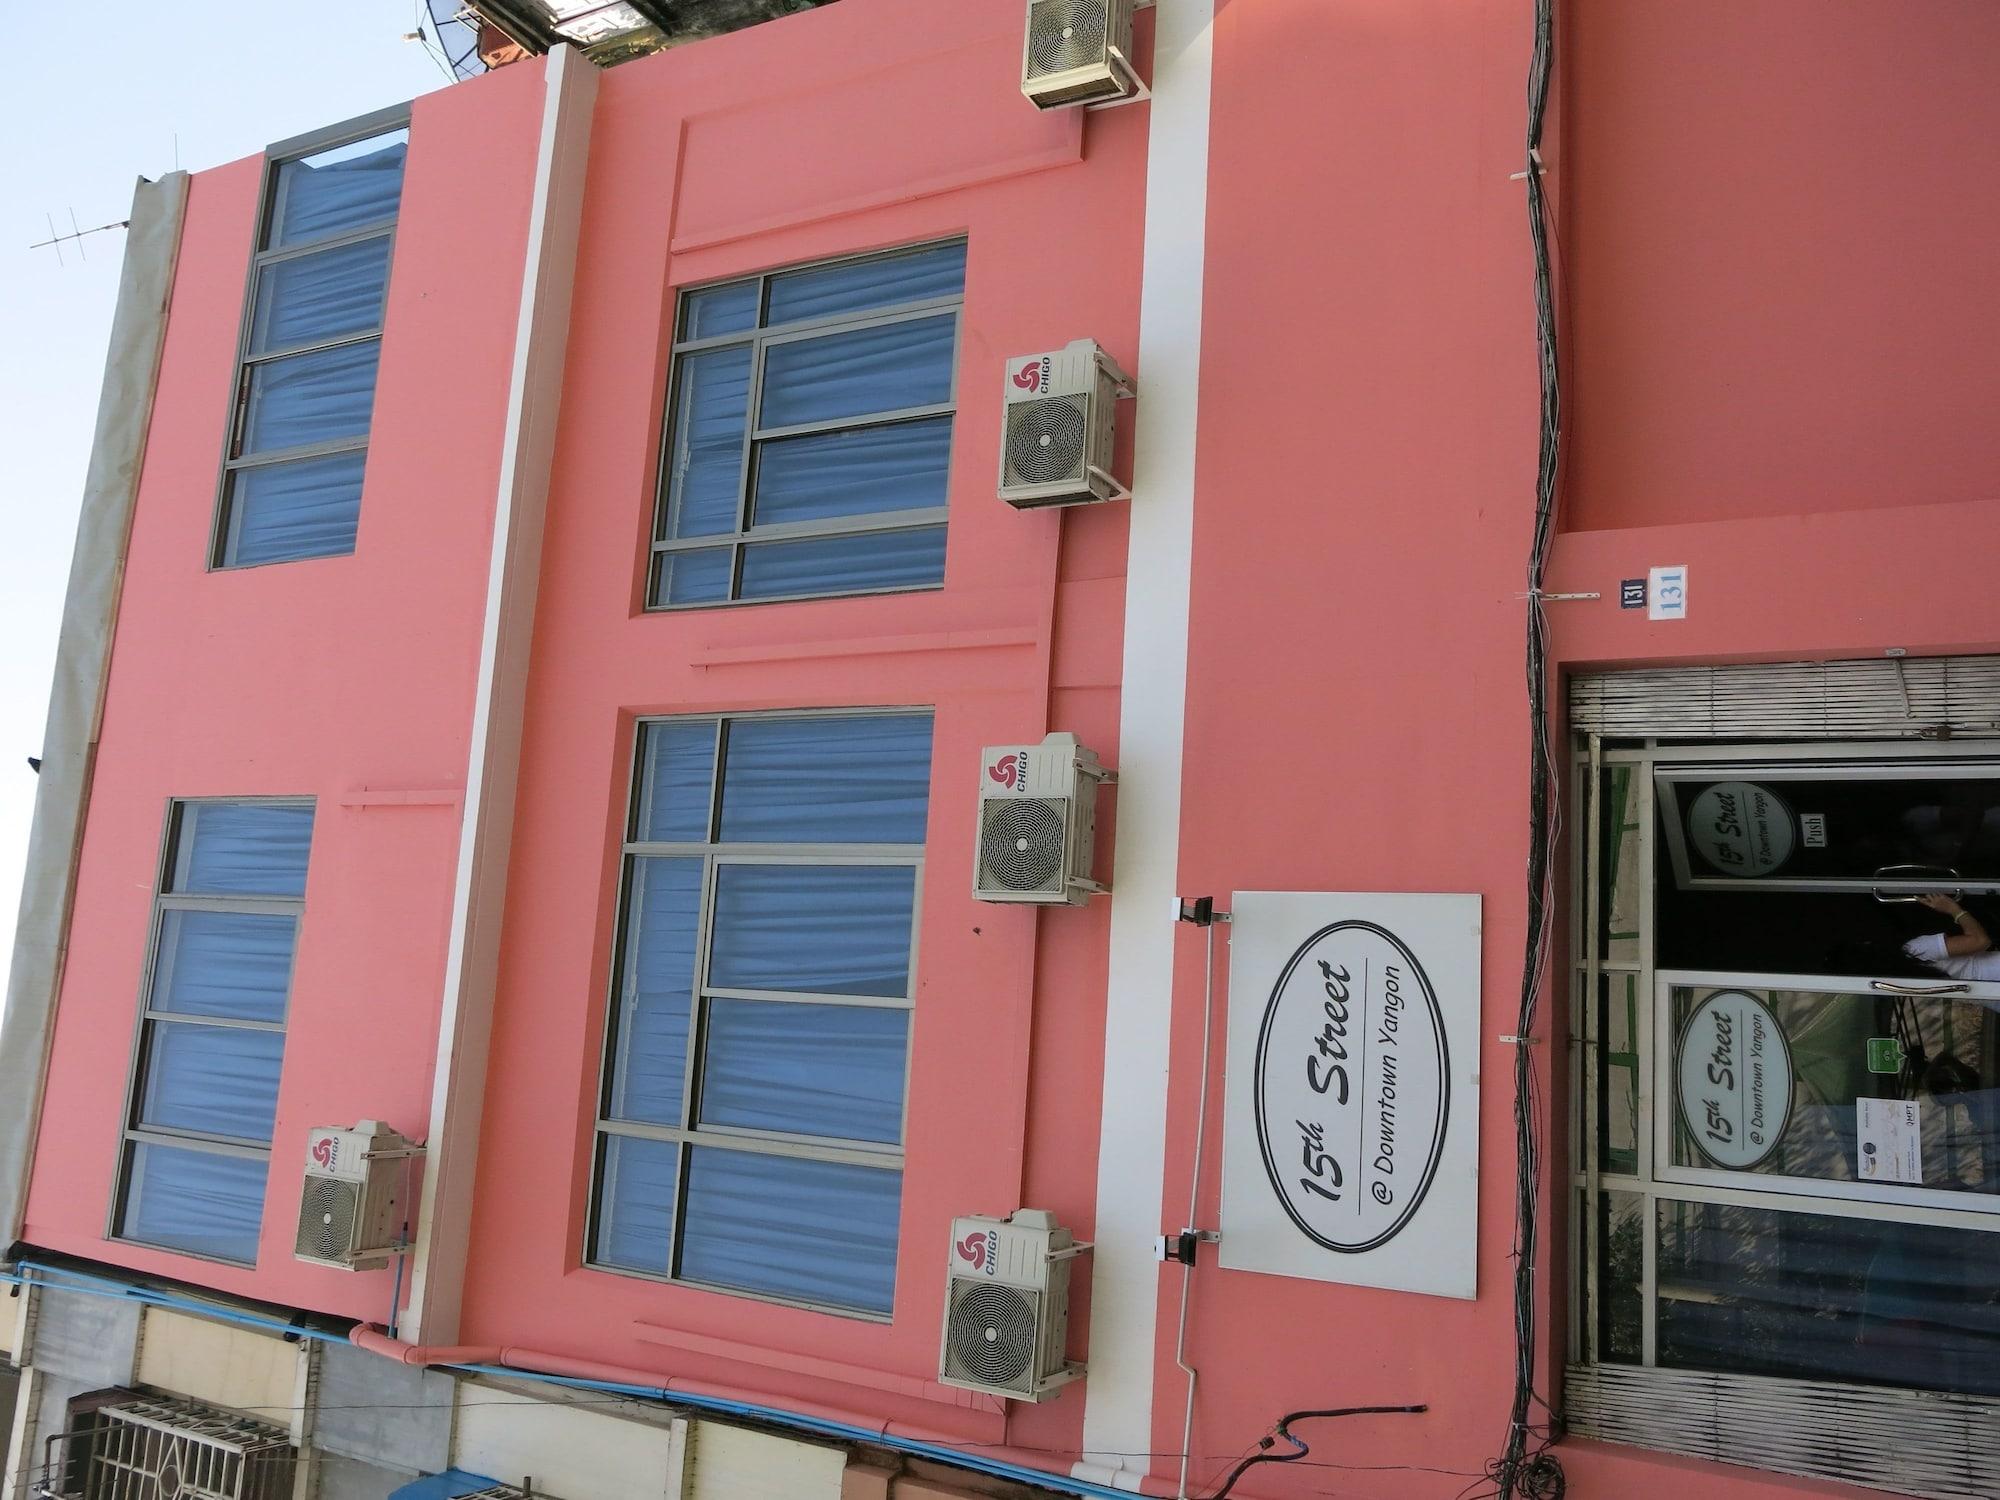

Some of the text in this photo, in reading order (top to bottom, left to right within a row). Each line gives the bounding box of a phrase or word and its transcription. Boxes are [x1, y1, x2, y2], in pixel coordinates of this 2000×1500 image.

[1041, 357, 1050, 394] CHIGO
[1624, 585, 1643, 604] 131
[1660, 574, 1681, 610] 131
[1017, 752, 1027, 792] CHIGO
[1753, 792, 1769, 818] Yangon
[1713, 792, 1744, 864] 15th Street
[1757, 821, 1770, 856] Downtown
[1805, 818, 1824, 844] Push
[1296, 960, 1351, 1201] 15th Street
[1371, 966, 1404, 1206] @ Downtown Yangon
[1702, 1010, 1734, 1144] 15th Street
[1750, 1014, 1766, 1145] @ Downtown Yangon
[330, 1137, 339, 1172] CHIGO
[986, 1230, 997, 1276] CHIGO
